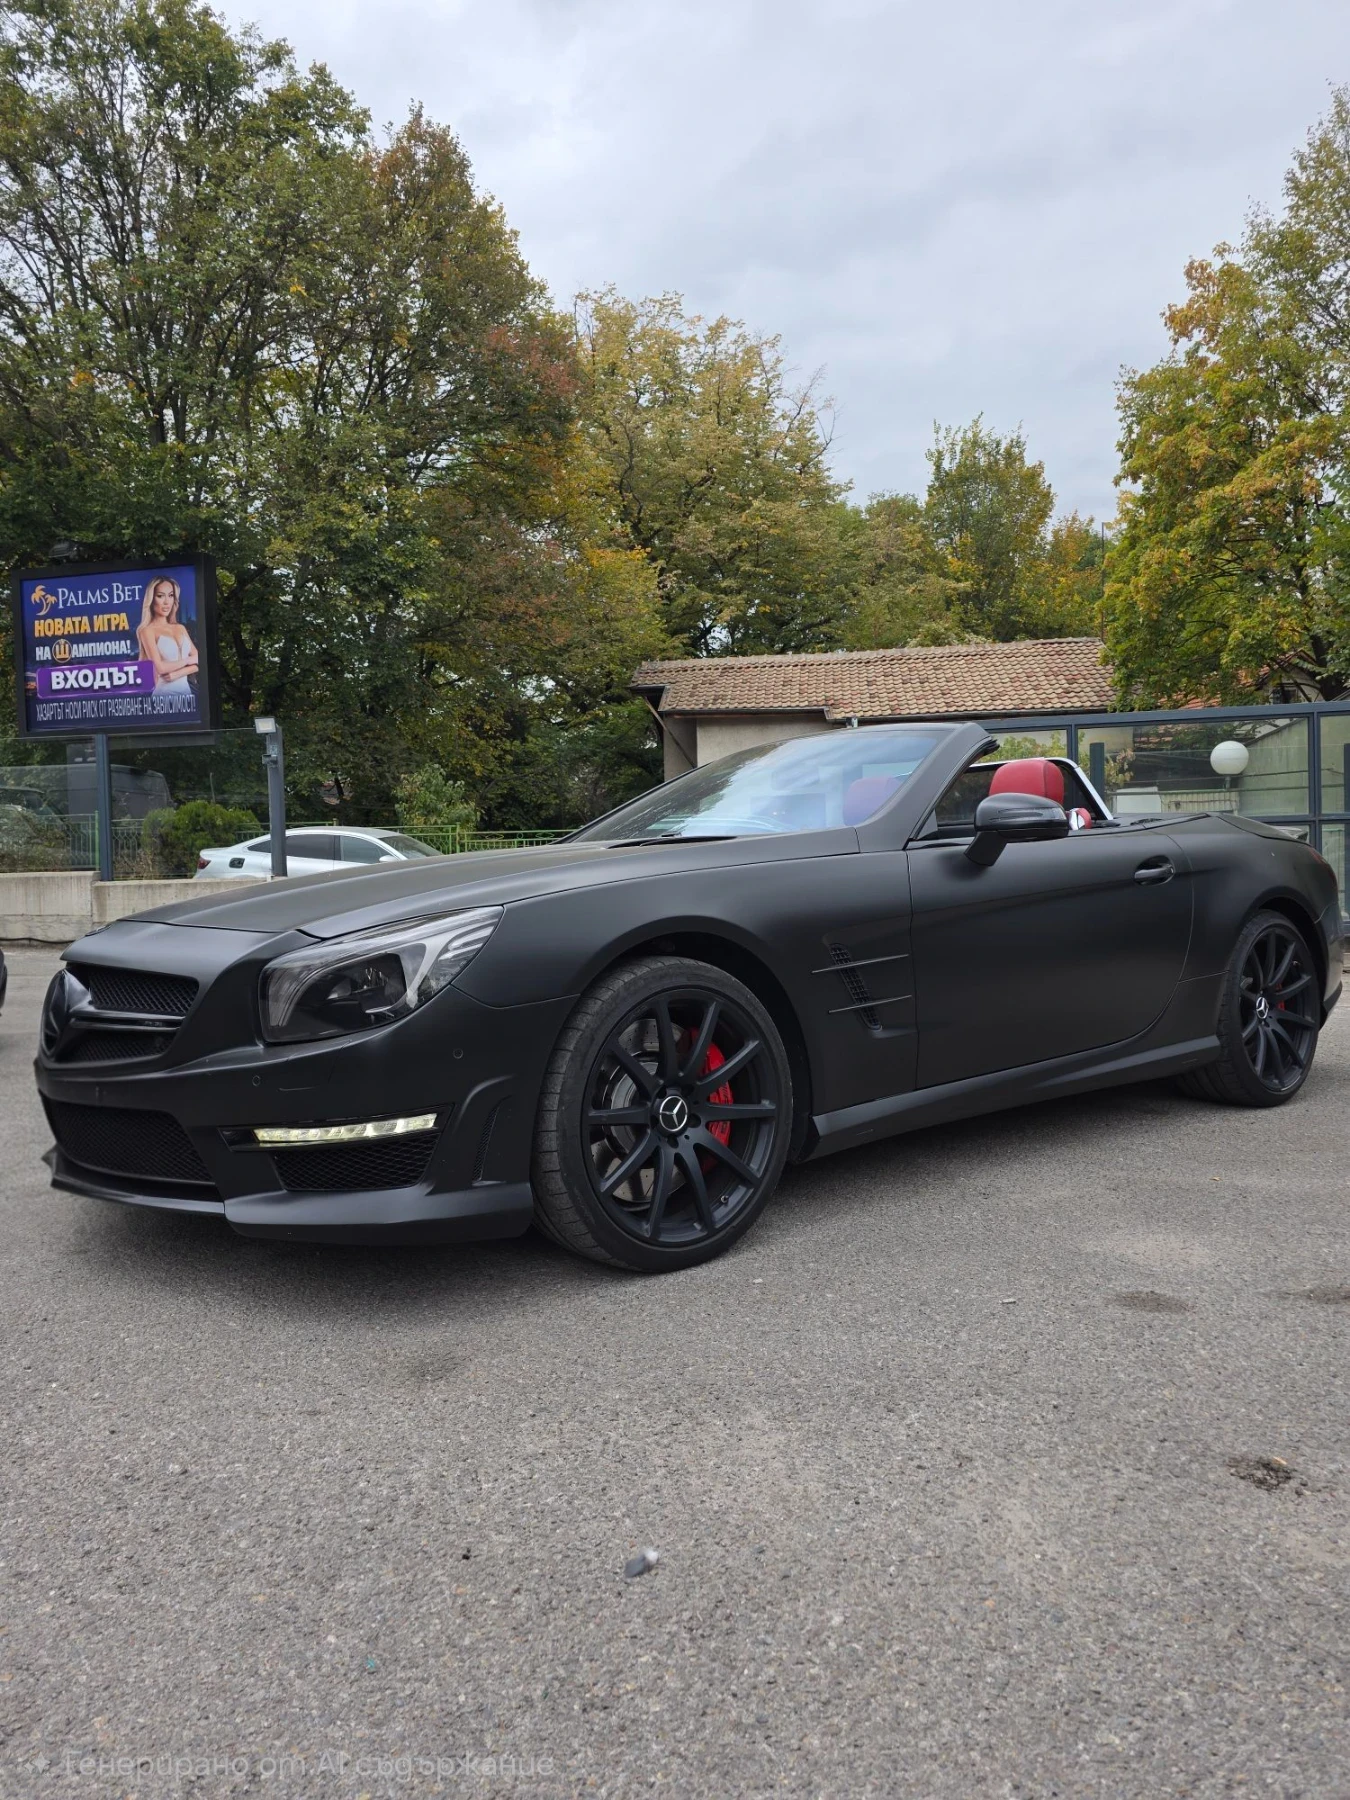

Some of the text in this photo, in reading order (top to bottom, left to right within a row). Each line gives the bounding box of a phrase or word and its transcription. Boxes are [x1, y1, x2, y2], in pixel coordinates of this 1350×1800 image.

[57, 582, 142, 609] PALMS BET
[34, 612, 130, 637] НОВАТА ИГРА
[35, 639, 131, 661] НА ШАМПИОНА!
[51, 666, 142, 690] ВХОДЪТ.
[36, 702, 65, 722] ХАЗАРТЪТ
[65, 701, 82, 720] НОСИ
[82, 700, 98, 718] РИСК
[98, 699, 107, 718] ОТ
[107, 697, 143, 717] РАЗВИВАНЕ
[143, 697, 153, 715] НА
